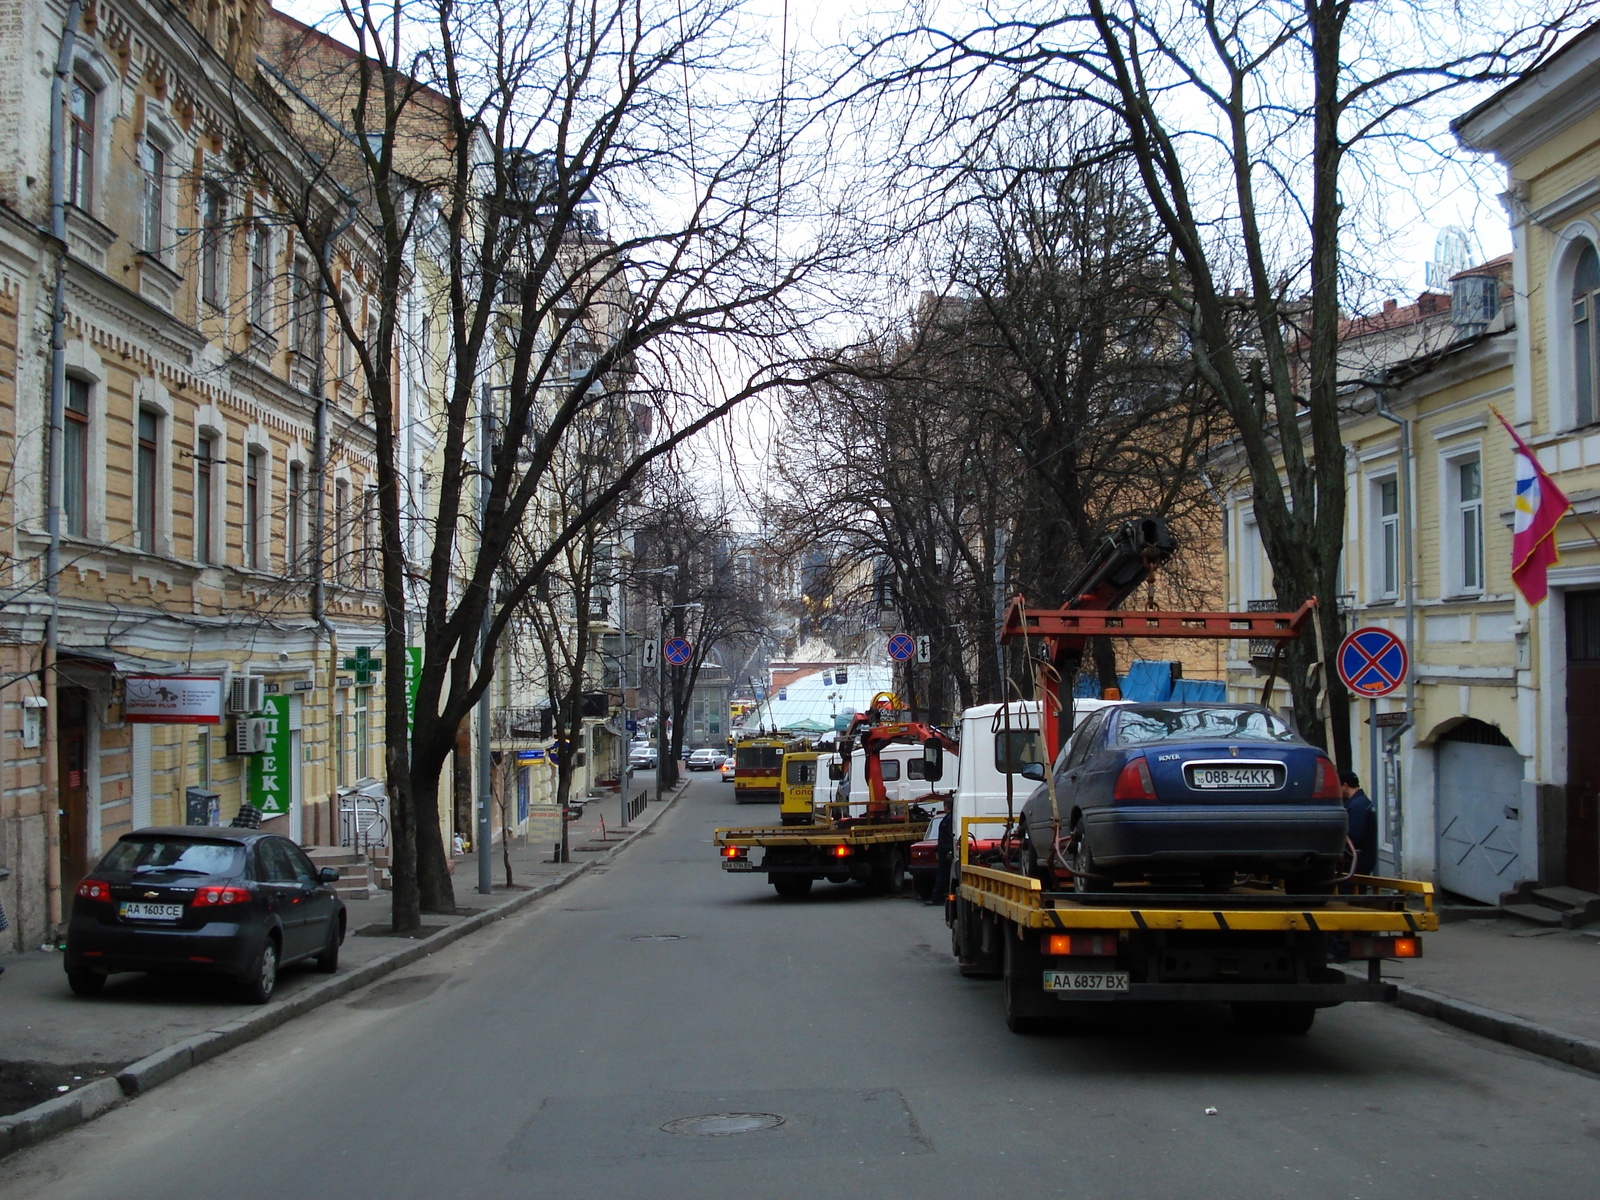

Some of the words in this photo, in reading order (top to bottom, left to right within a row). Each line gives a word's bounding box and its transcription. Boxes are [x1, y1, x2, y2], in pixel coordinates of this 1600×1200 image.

[262, 699, 280, 811] АПТЕКА
[126, 904, 140, 914] AA
[144, 905, 164, 915] 1603
[1053, 975, 1071, 988] AA
[1074, 975, 1103, 988] 6837
[1106, 976, 1125, 988] BX
